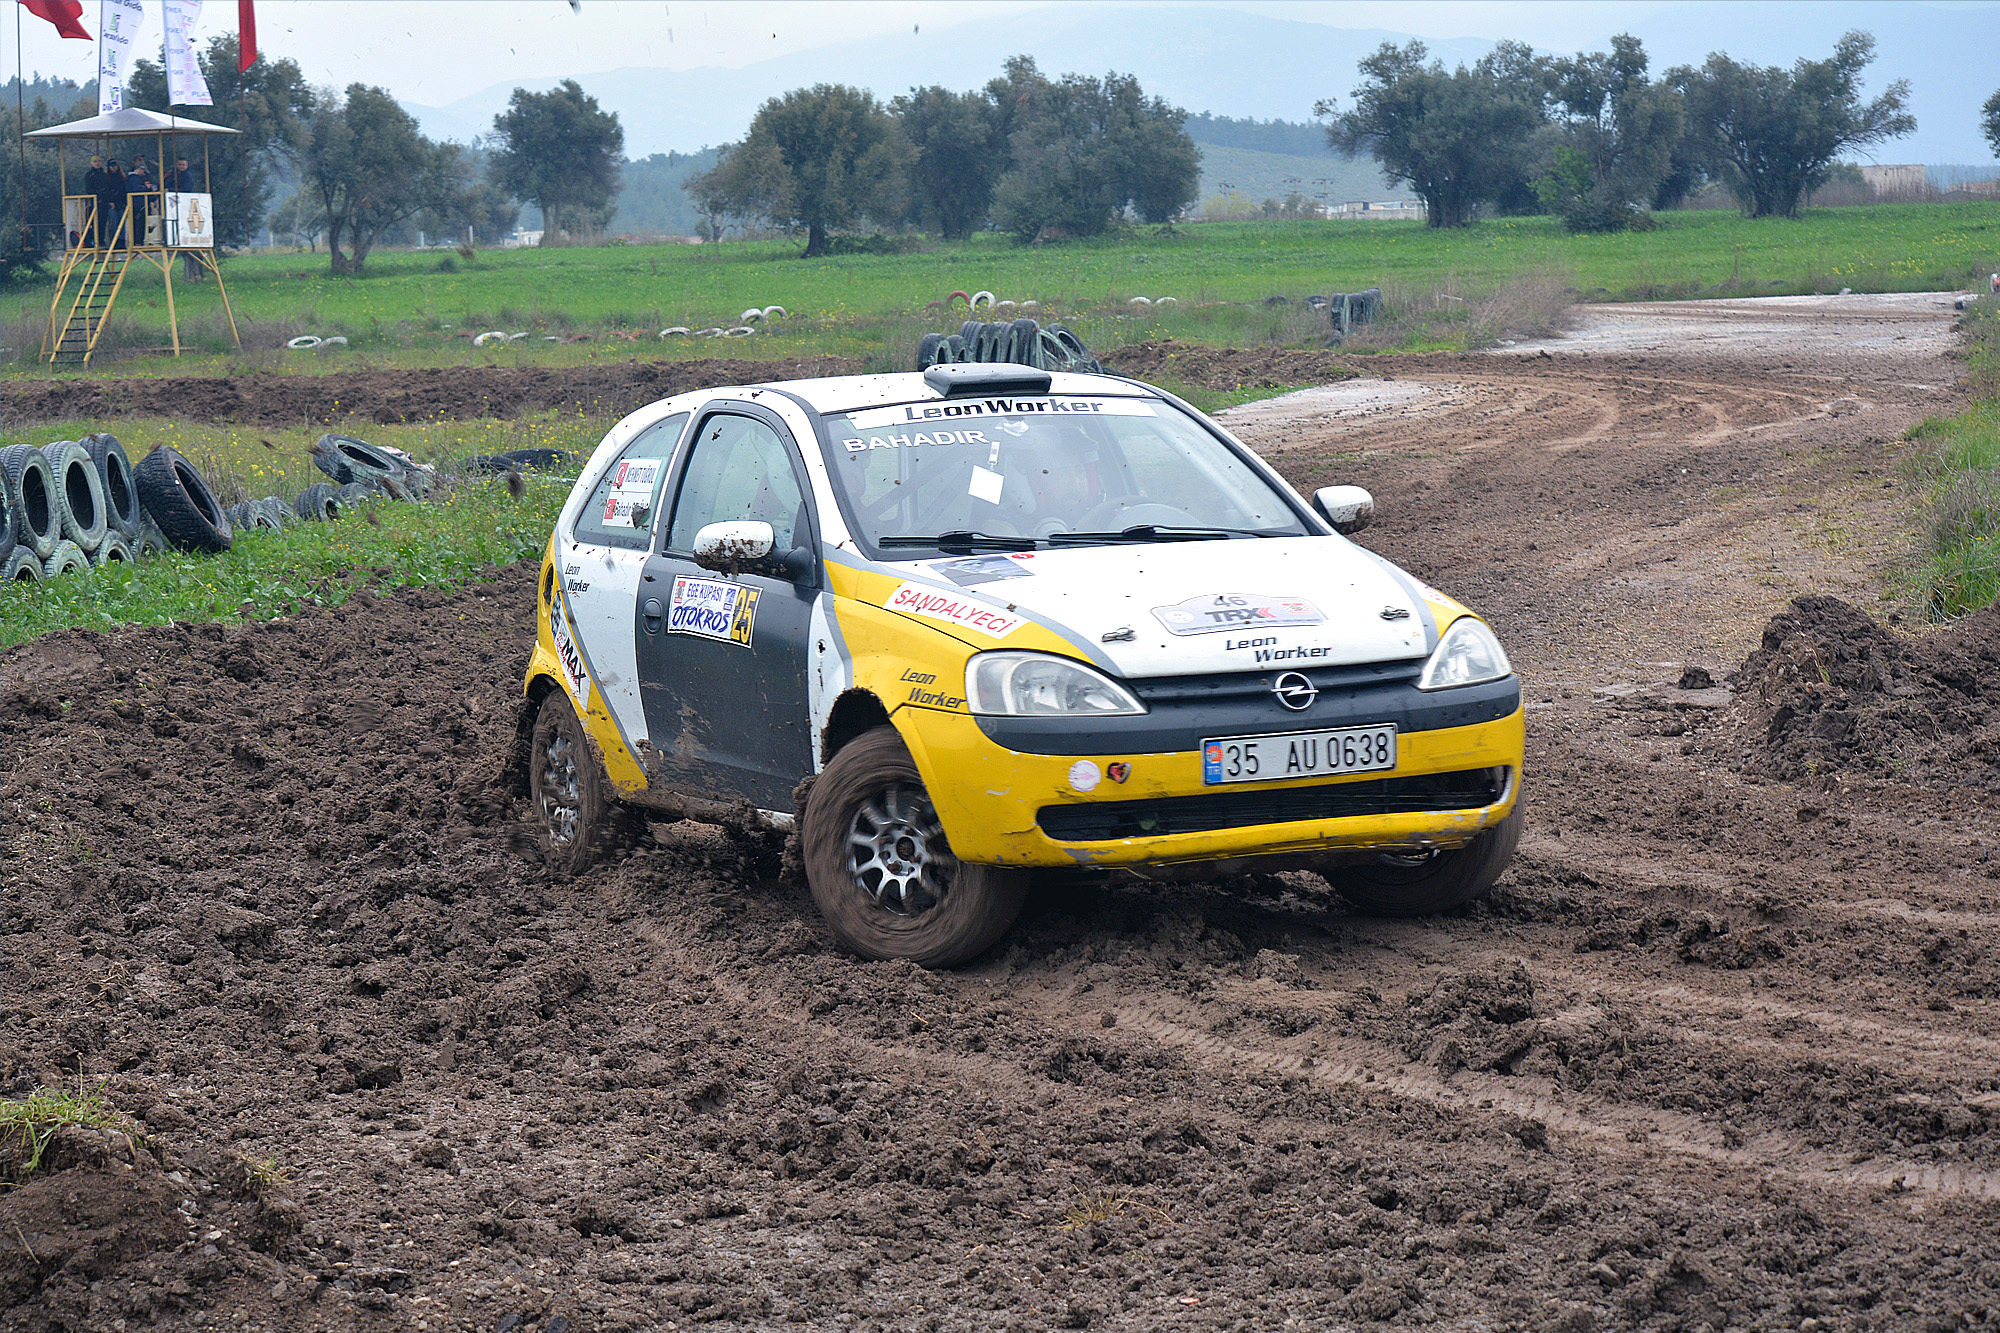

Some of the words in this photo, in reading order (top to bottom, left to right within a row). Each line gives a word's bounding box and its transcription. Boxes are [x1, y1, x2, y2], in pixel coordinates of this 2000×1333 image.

[842, 430, 990, 453] BAHADIR
[565, 562, 581, 575] Leon
[567, 579, 590, 592] Worker
[687, 583, 701, 598] EGE
[699, 584, 724, 602] KUPASI
[894, 589, 1017, 633] SANDALYECİ
[1213, 596, 1248, 608] 46
[671, 605, 731, 633] OTOKROS
[731, 588, 759, 644] 25
[1205, 607, 1267, 623] TRX
[1226, 637, 1277, 651] Leon
[1255, 646, 1332, 663] Worker
[562, 637, 587, 694] MAX
[900, 668, 936, 685] Leon
[908, 687, 967, 709] Worker
[1226, 743, 1259, 777] 35
[1286, 739, 1317, 774] AU
[1327, 732, 1388, 769] 0638
